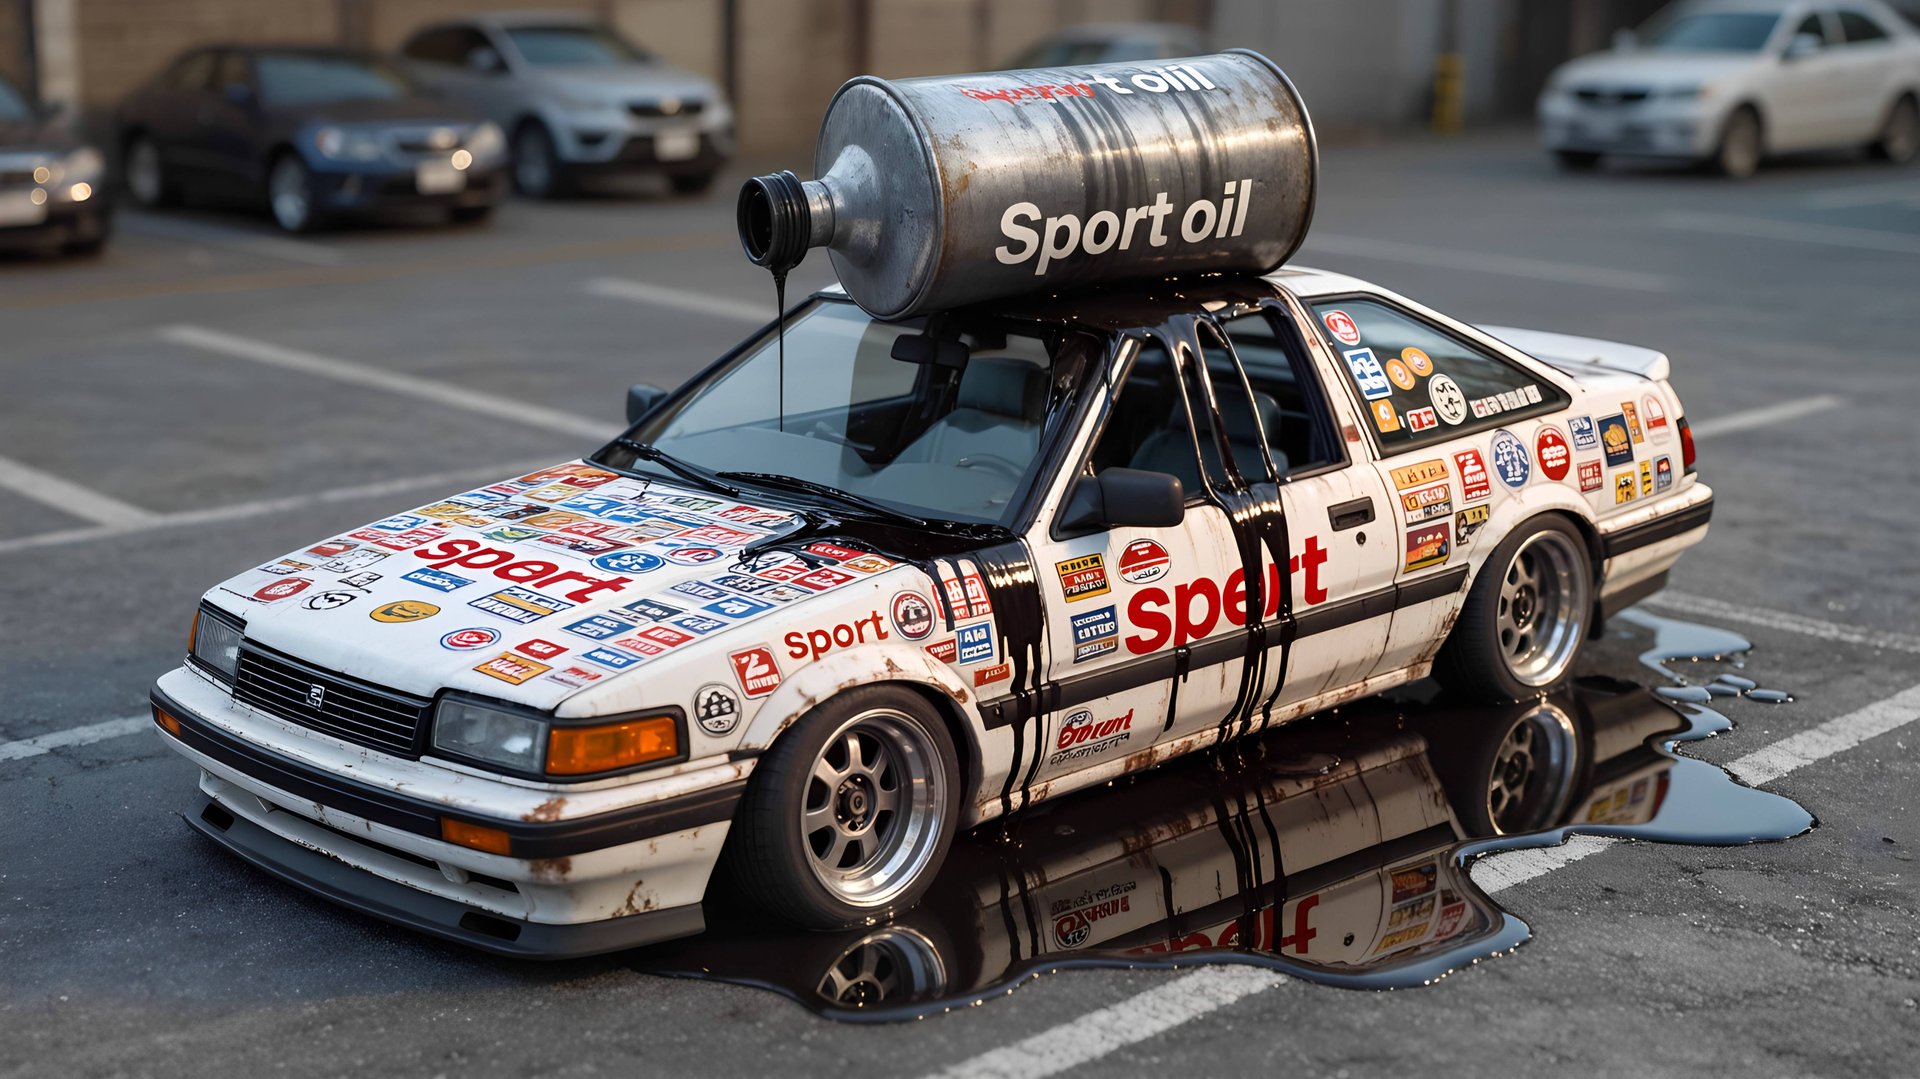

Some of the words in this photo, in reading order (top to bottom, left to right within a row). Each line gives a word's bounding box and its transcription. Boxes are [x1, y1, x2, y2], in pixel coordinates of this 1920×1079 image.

[995, 191, 1174, 275] Sport
[1180, 179, 1252, 244] oil
[784, 610, 889, 662] sport
